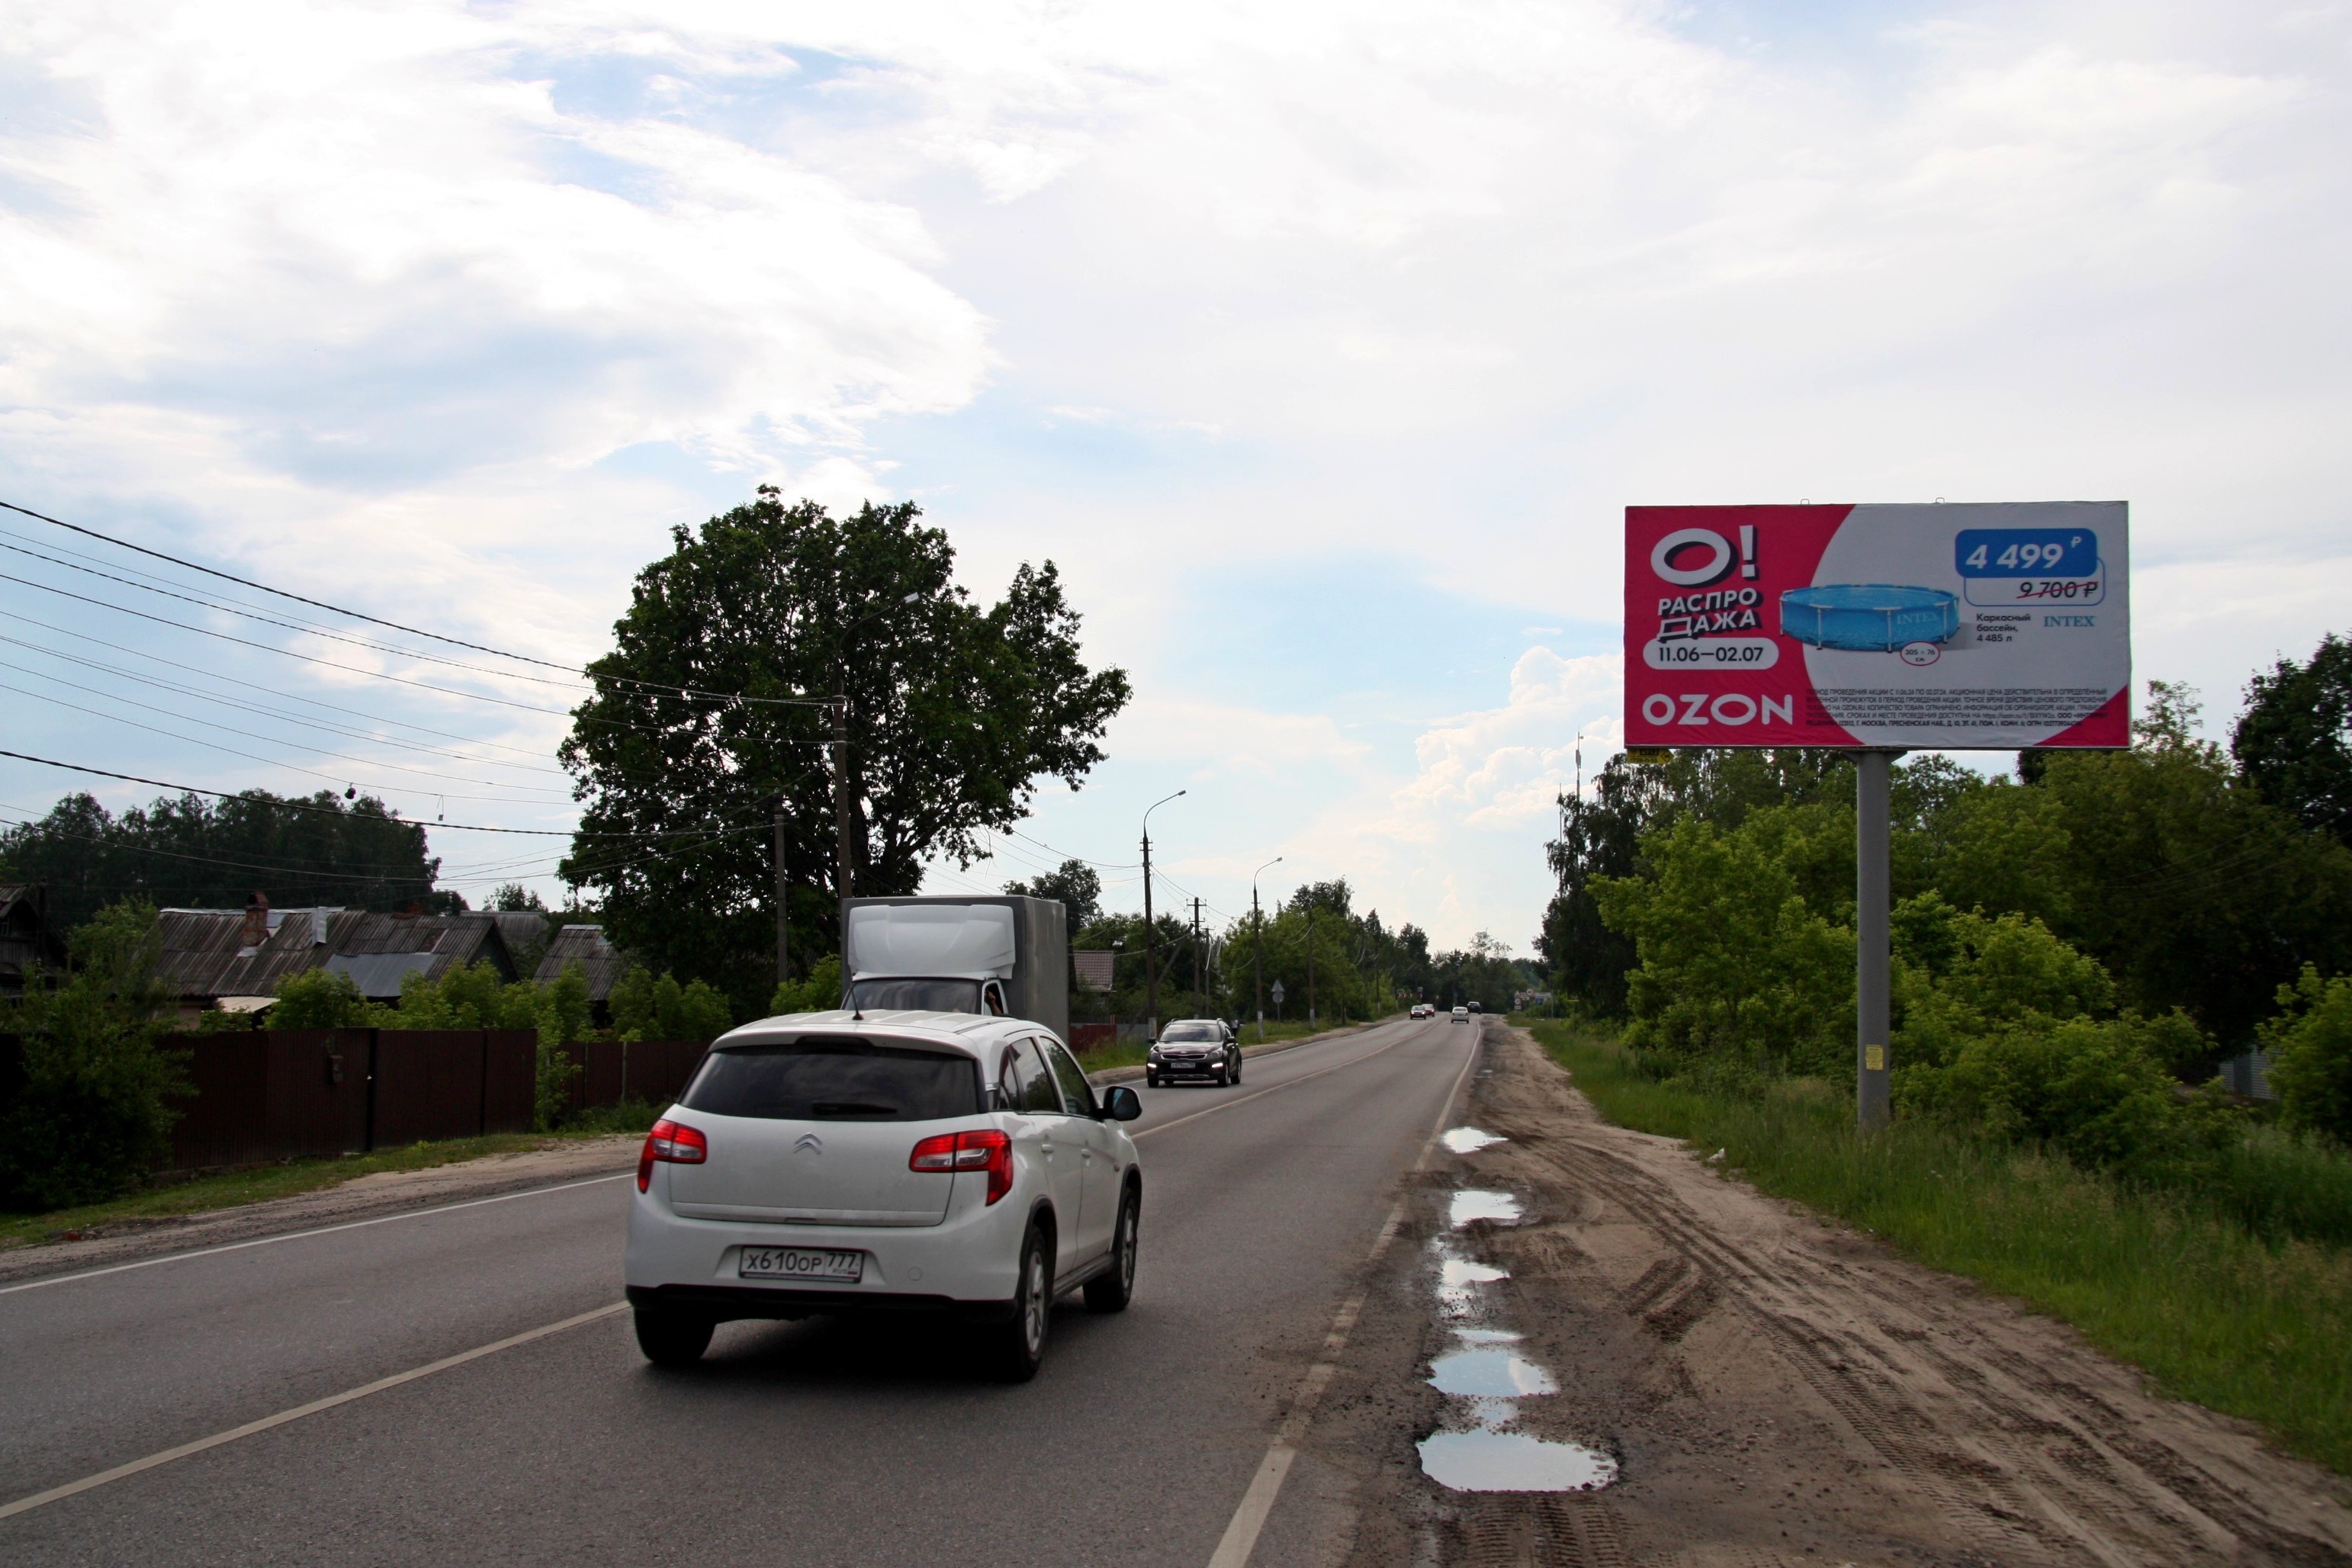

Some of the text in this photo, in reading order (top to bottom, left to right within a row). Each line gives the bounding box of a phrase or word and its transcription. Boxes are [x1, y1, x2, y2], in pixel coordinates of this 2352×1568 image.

[1965, 545, 1987, 569] 4
[1997, 543, 2064, 570] 499
[2038, 581, 2077, 599] 700
[1657, 588, 1758, 616] РАСПРО
[1656, 609, 1757, 640] ДАЖА
[1976, 613, 2031, 622] Каркасный
[2043, 615, 2096, 628] INTEX
[1976, 623, 2019, 634] бассейн,
[1985, 634, 2003, 642] 485
[1642, 693, 1794, 726] OZON
